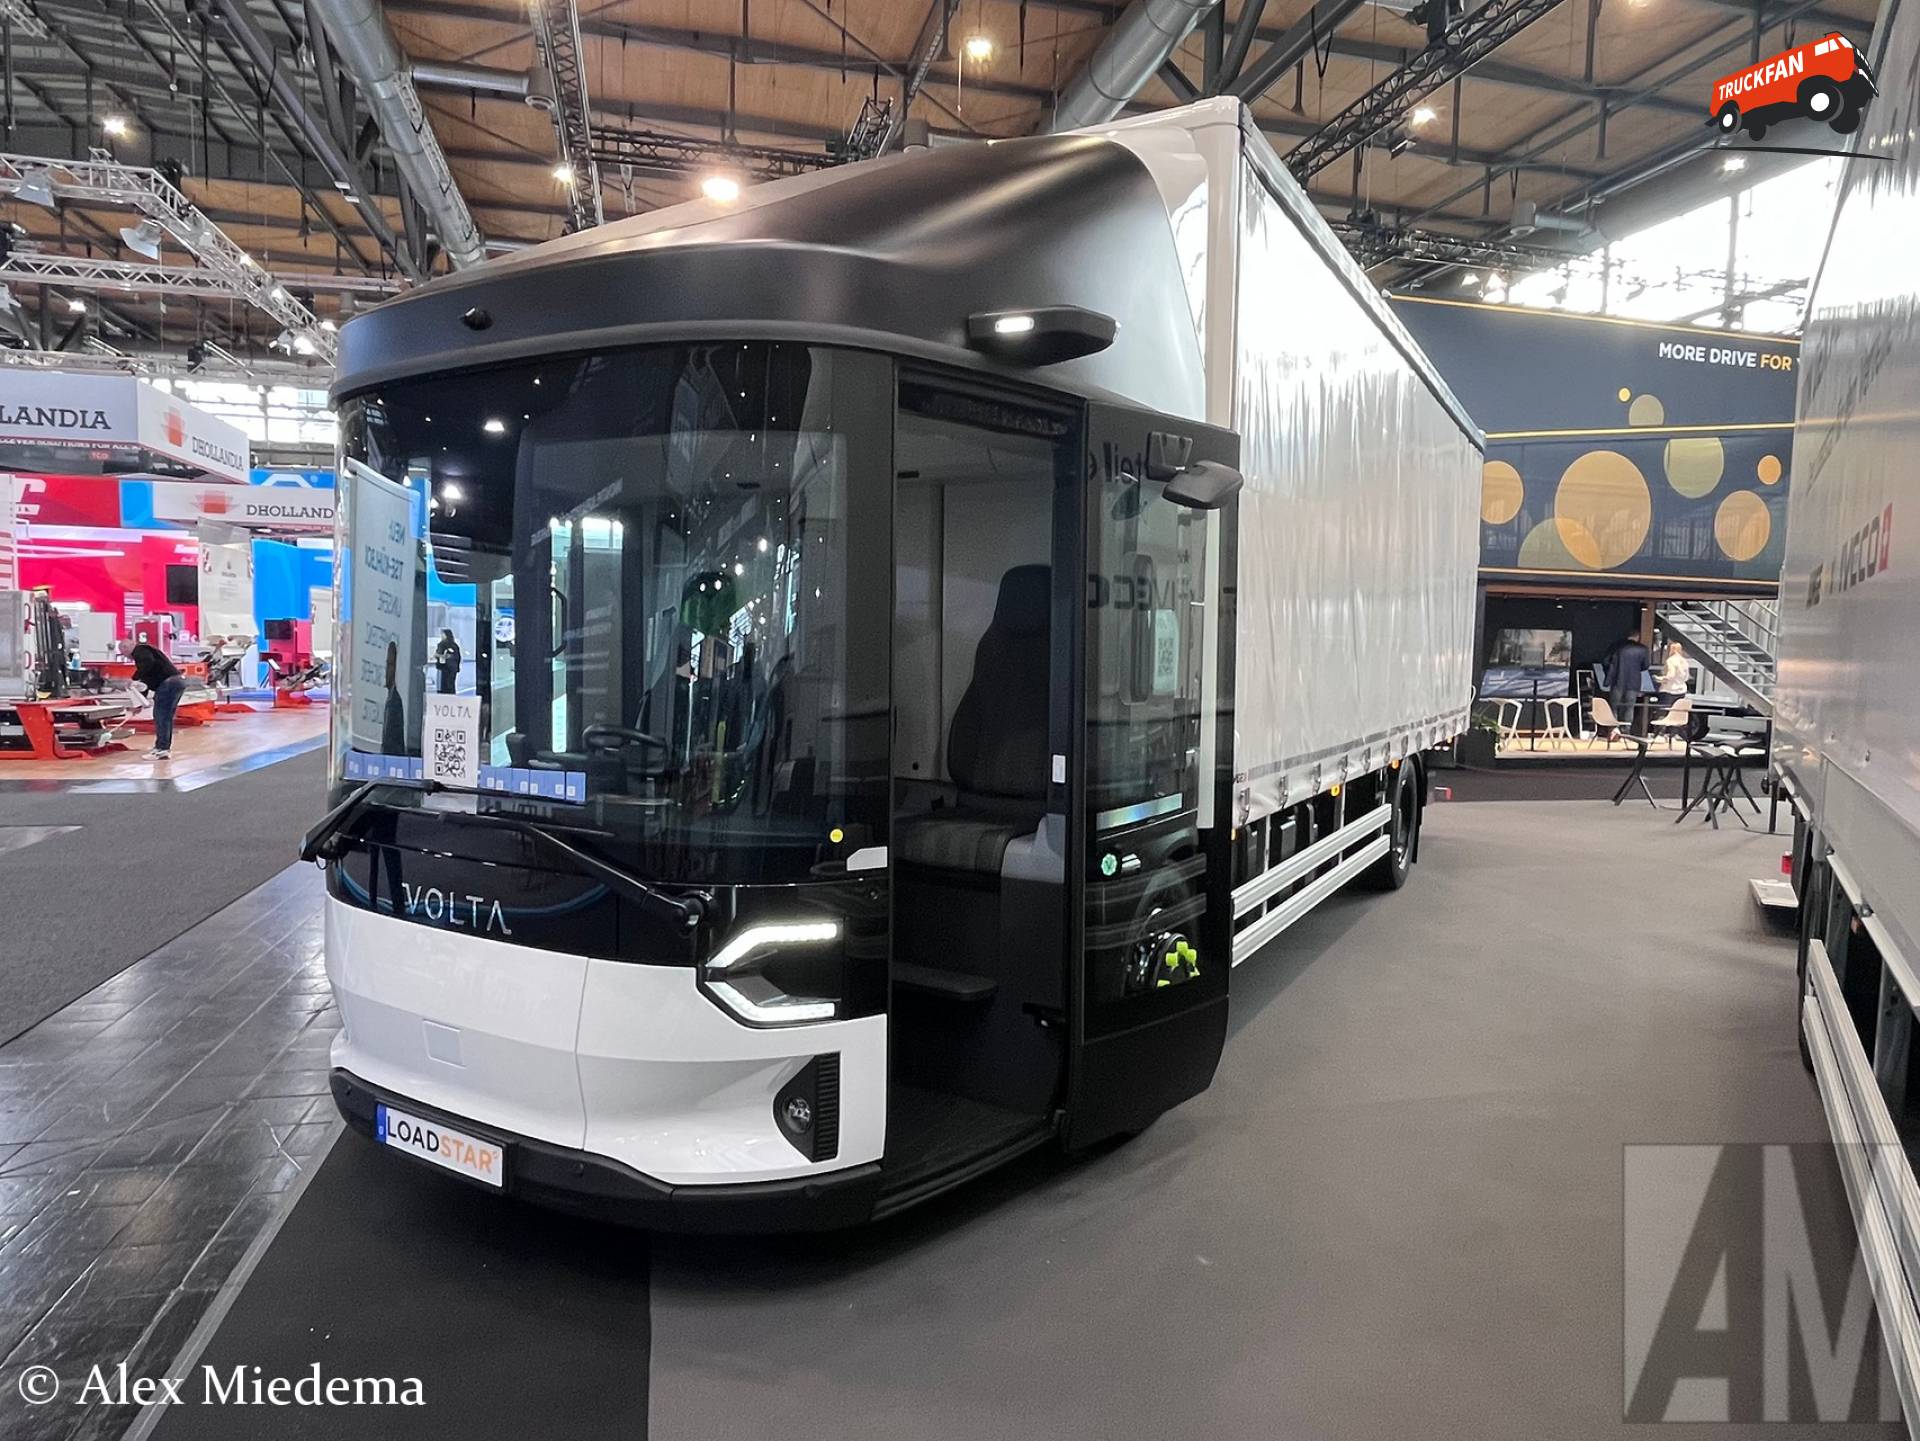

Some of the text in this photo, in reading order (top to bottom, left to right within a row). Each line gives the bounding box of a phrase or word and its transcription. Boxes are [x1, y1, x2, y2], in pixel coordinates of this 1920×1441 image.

[1659, 341, 1706, 362] MORE
[1709, 348, 1758, 368] DRIVE
[1760, 354, 1793, 371] FOR
[192, 436, 244, 472] DHOLLANDIA
[433, 704, 473, 720] VOLTA
[401, 882, 512, 935] VOLTA
